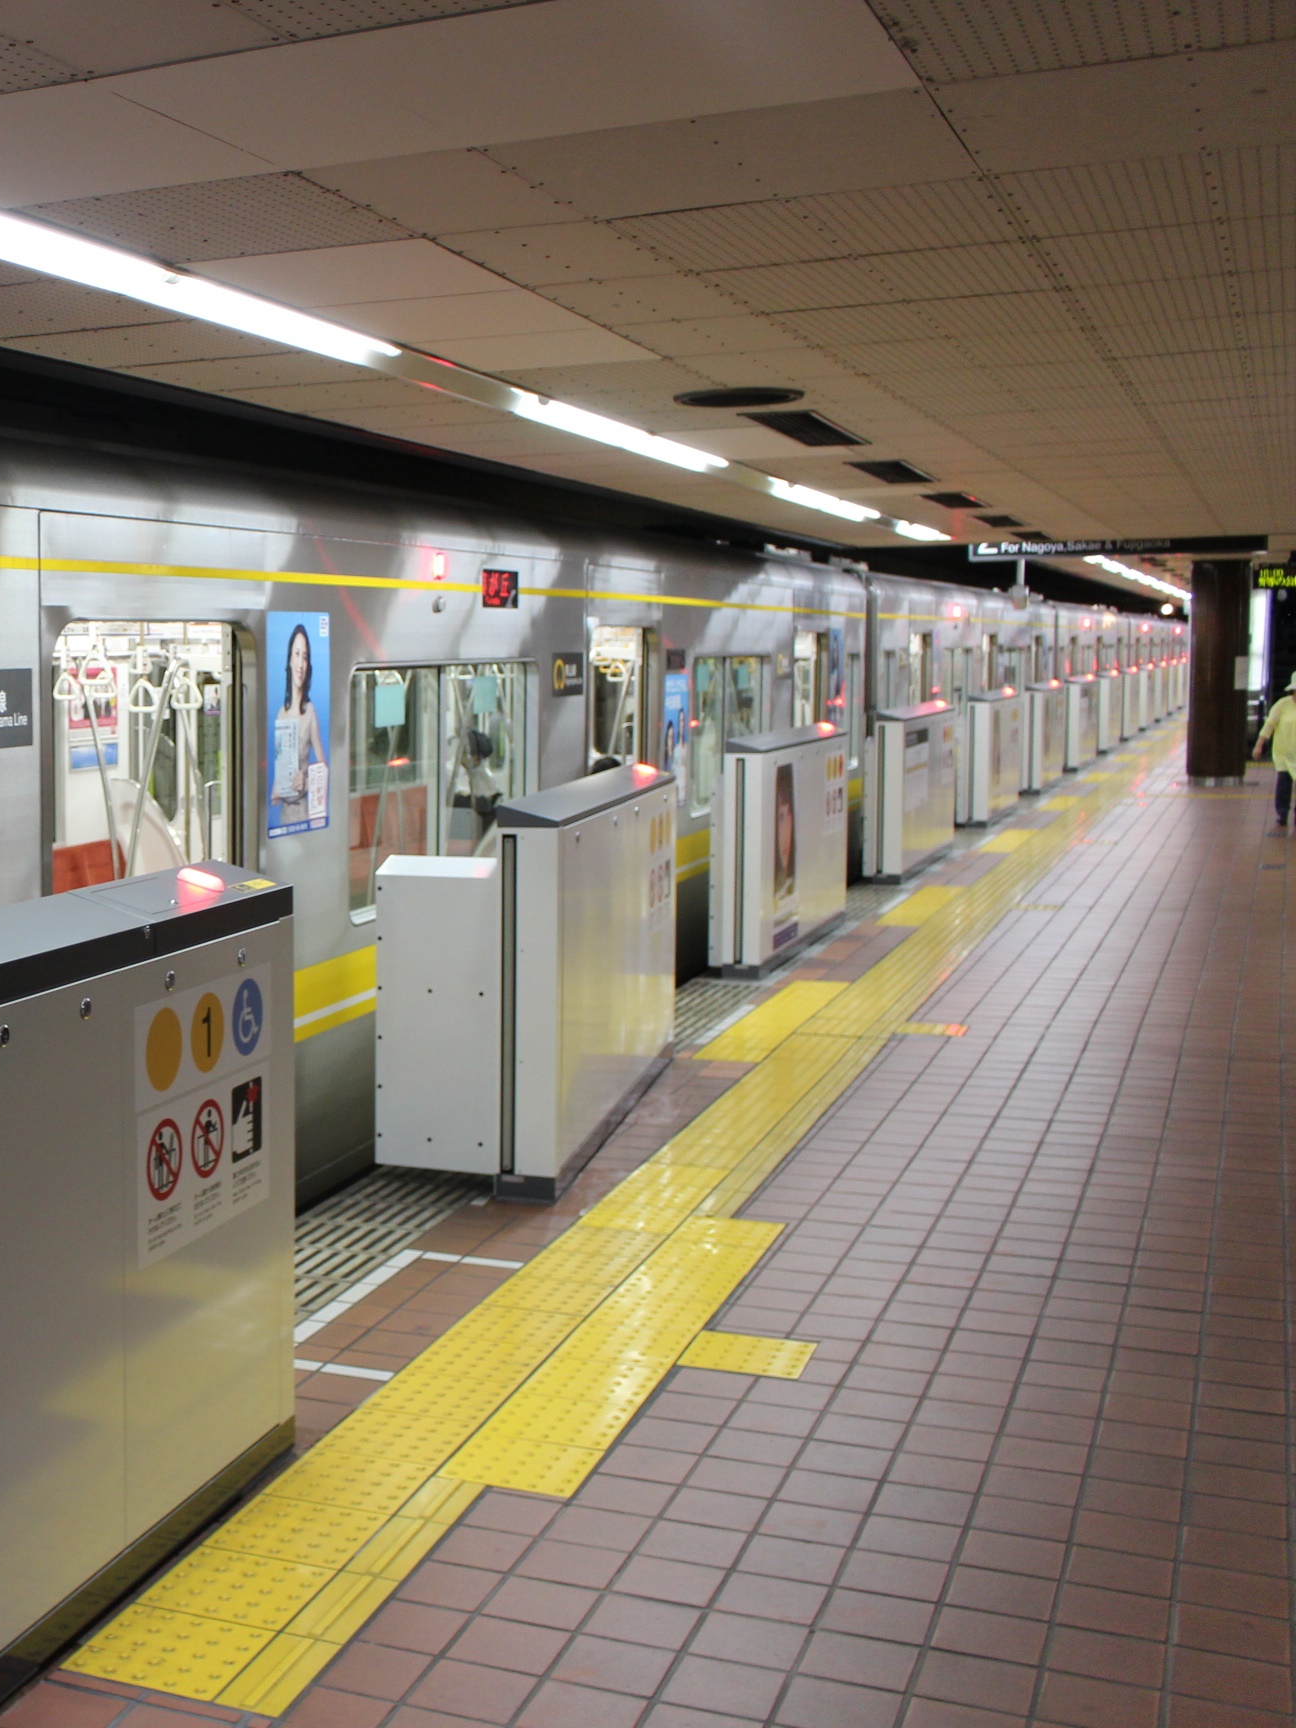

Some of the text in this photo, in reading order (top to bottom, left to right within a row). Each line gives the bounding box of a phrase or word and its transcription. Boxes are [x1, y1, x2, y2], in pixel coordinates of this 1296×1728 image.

[1001, 541, 1020, 553] For
[13, 712, 28, 727] Line
[202, 1006, 211, 1057] 1
